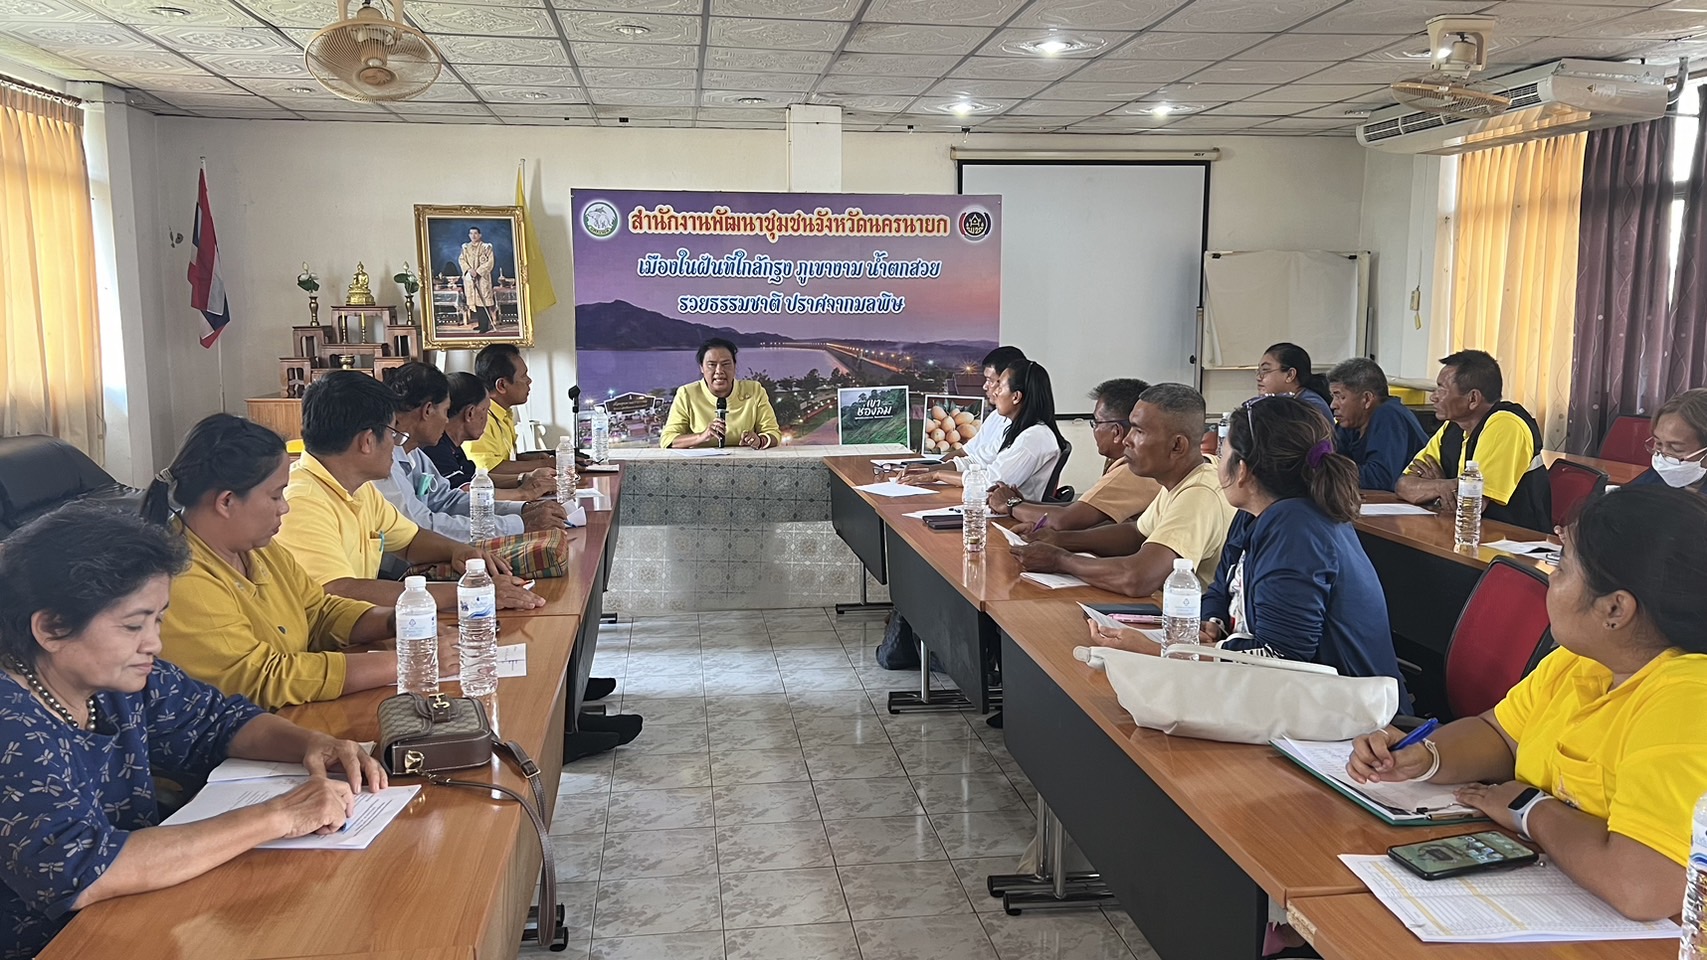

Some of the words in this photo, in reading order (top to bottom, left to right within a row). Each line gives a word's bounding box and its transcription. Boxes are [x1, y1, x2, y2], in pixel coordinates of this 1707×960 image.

[630, 207, 949, 241] สำนักงานพัฒนาชุมชนจังหวัดนครนายก
[638, 249, 793, 284] เมืองในฝันที่ใกล้กรุง
[796, 260, 864, 284] ภูเขางาม
[867, 251, 941, 277] น้ำตกสวย
[678, 292, 782, 313] รวยธรรมชาติ
[785, 292, 905, 313] ปราศจากมลพิษ
[857, 404, 892, 416] ช่องลม
[866, 399, 881, 408] เขา
